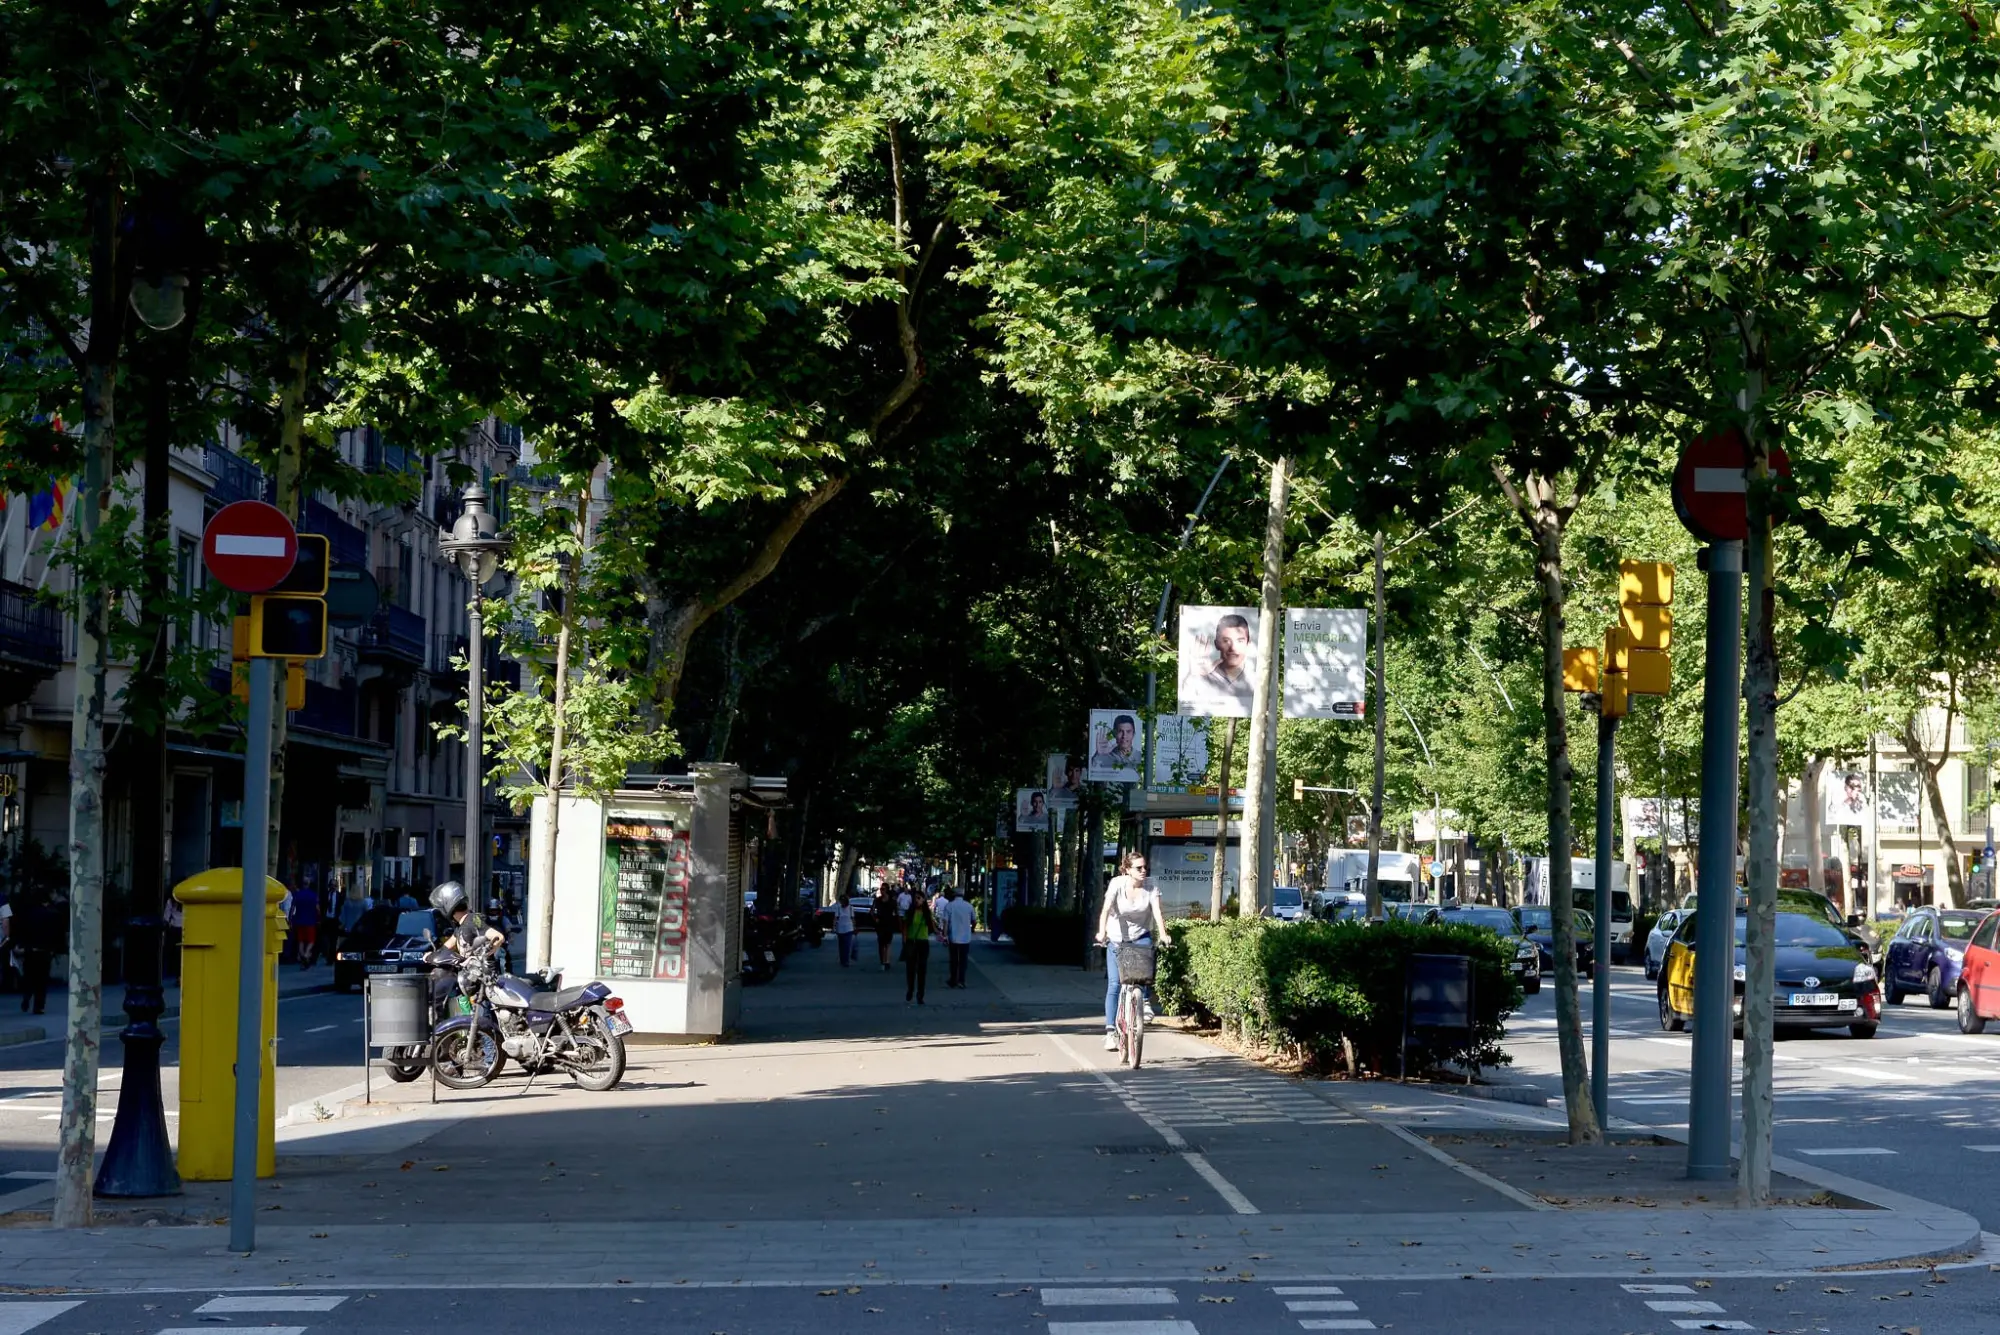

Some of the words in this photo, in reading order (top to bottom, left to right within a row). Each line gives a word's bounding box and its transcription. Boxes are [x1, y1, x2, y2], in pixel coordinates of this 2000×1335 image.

[1293, 620, 1321, 631] Envia
[1293, 633, 1349, 643] MEMORIA
[1292, 644, 1302, 654] al
[651, 827, 674, 839] 2006
[1795, 994, 1816, 1004] 8241
[1818, 994, 1836, 1004] HPP
[1840, 1000, 1856, 1010] SP
